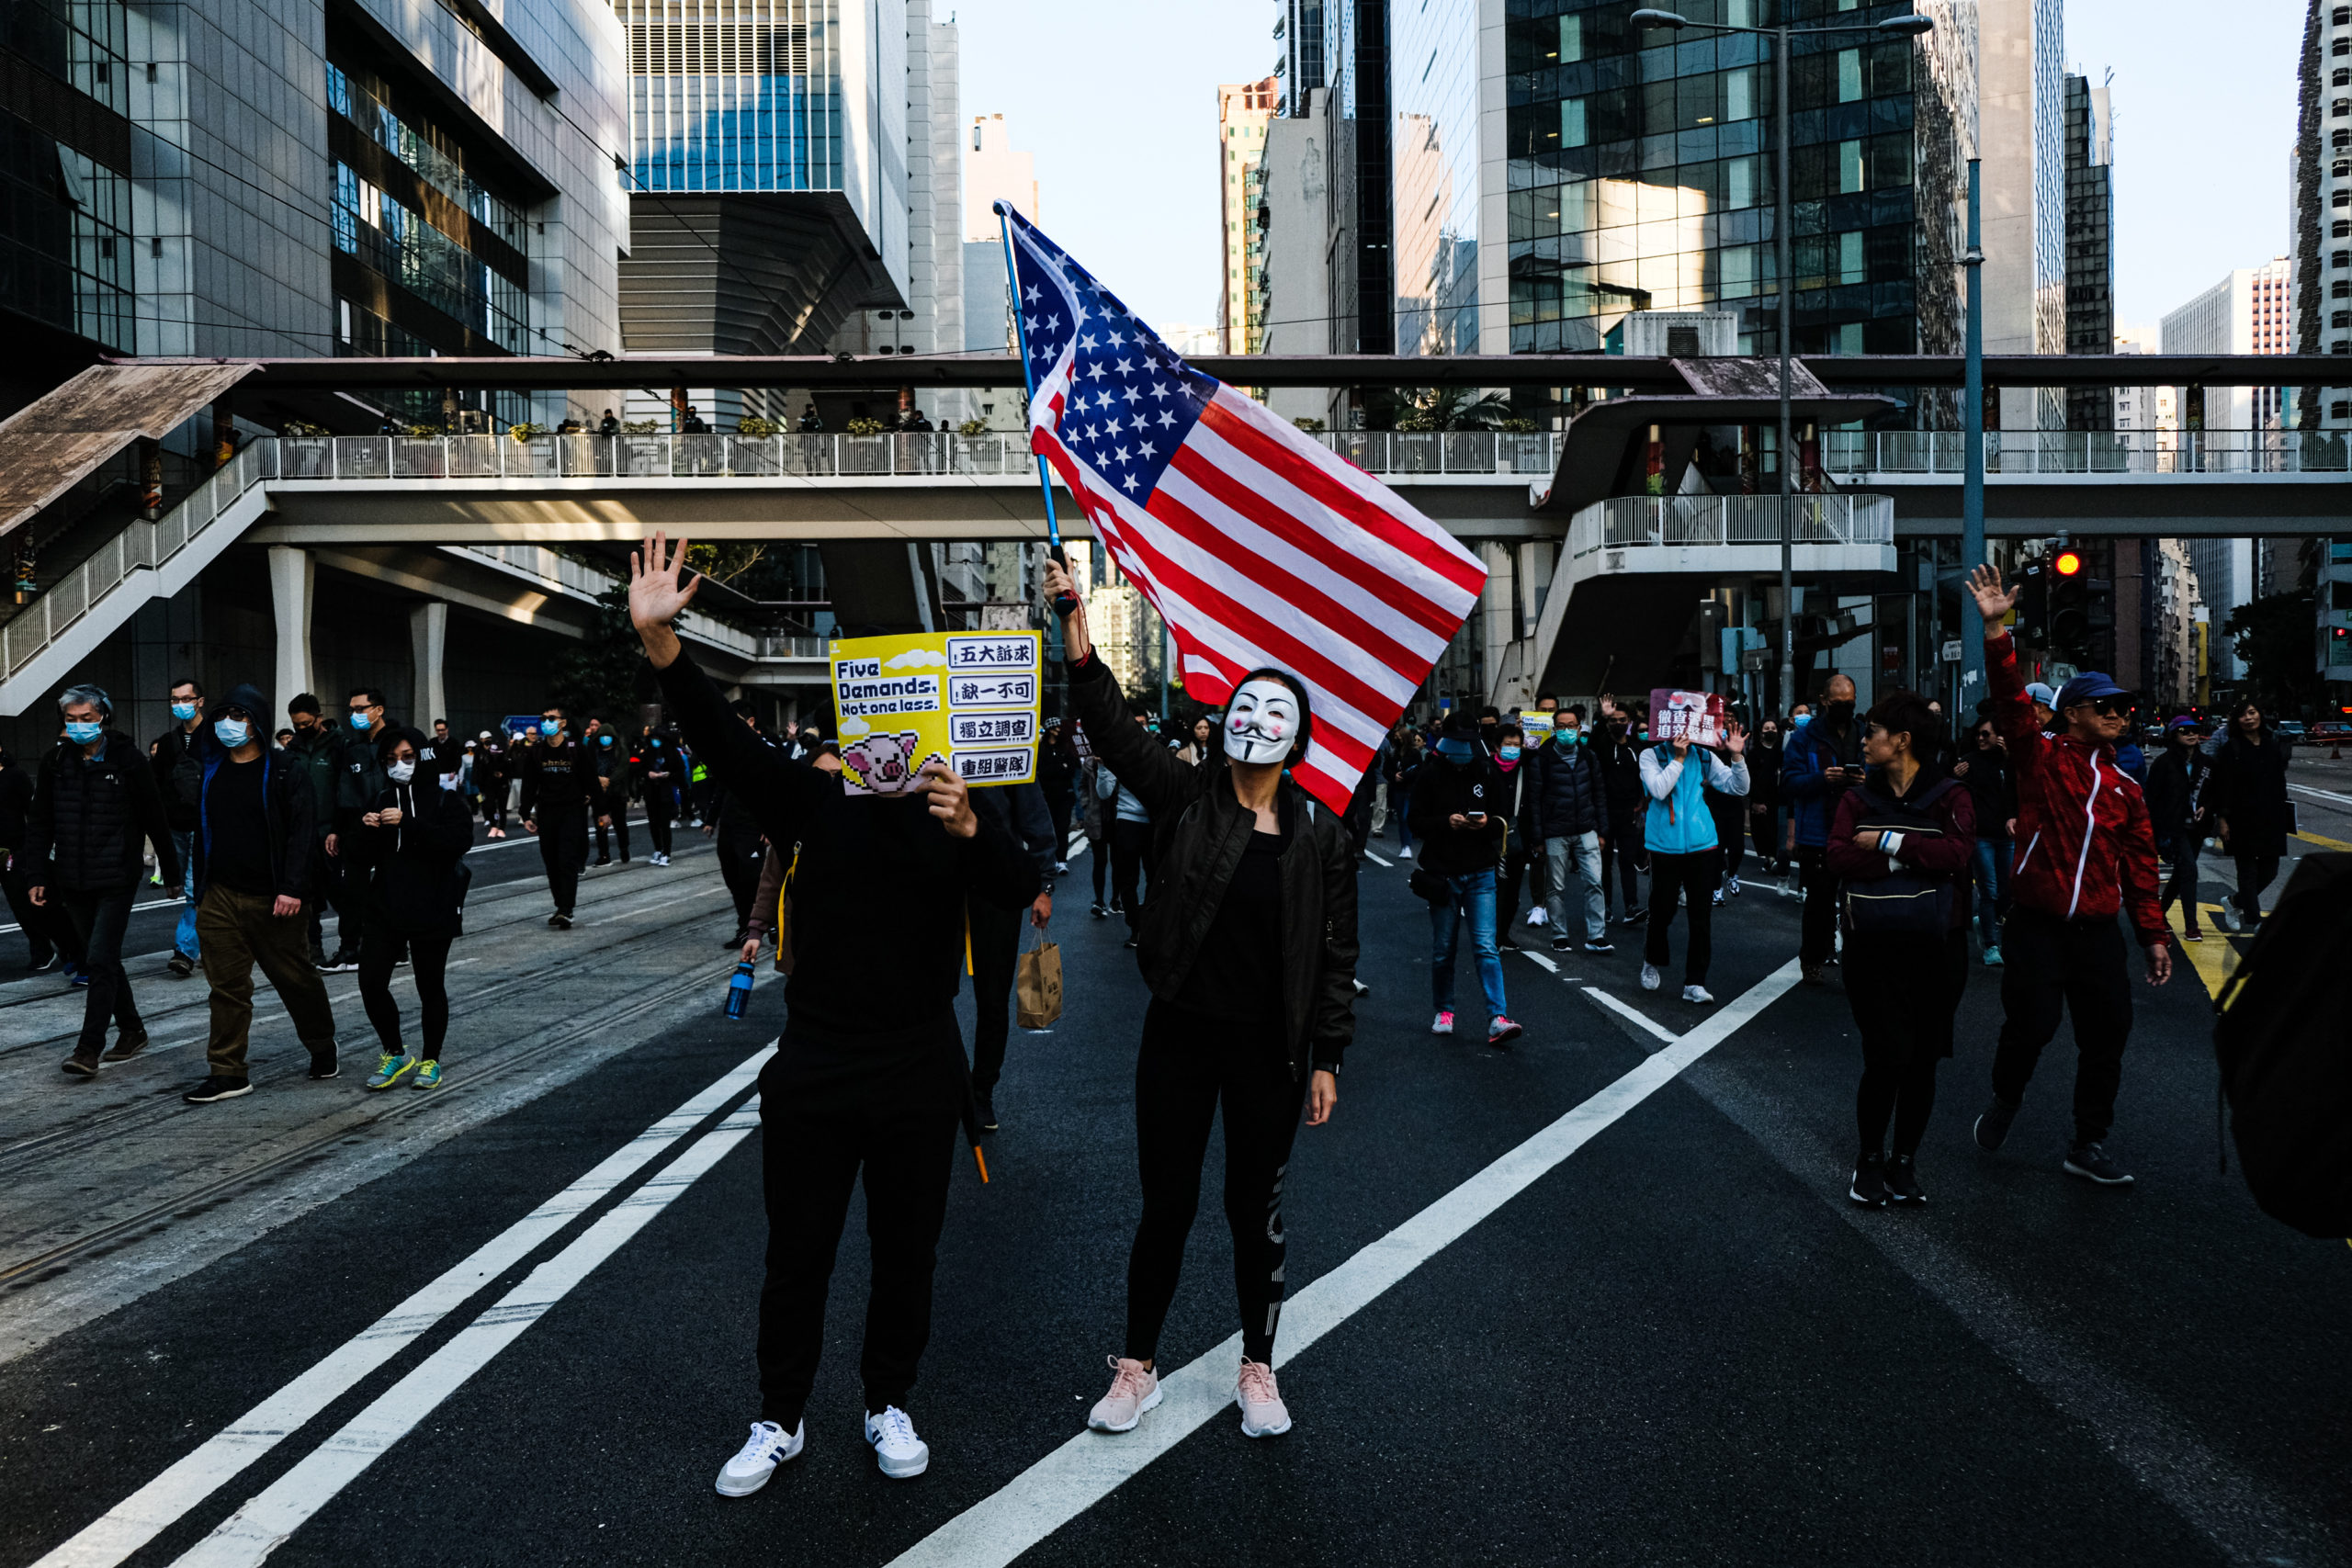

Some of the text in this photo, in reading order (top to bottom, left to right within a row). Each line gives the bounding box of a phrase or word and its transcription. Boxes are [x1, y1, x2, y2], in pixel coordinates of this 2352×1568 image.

[837, 661, 879, 679] Five
[839, 677, 937, 700] Demands,
[841, 699, 938, 716] Not one less.
[959, 719, 1027, 739] 獨立調查
[961, 756, 1023, 776] 重組警隊
